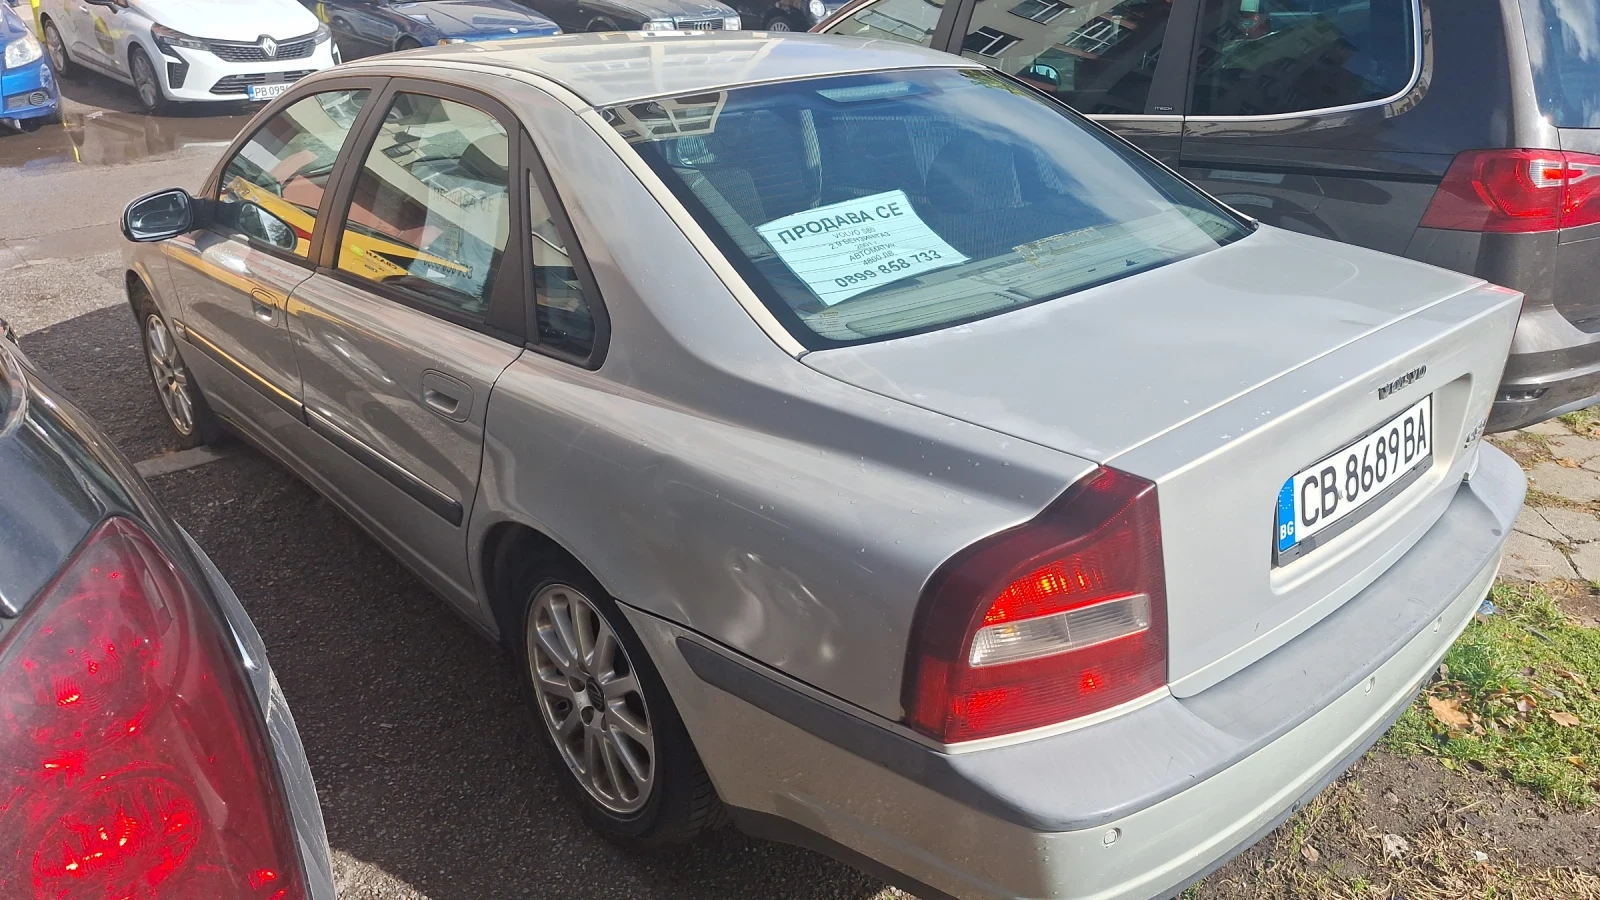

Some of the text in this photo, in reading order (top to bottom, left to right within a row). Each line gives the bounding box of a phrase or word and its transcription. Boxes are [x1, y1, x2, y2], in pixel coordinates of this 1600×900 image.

[777, 202, 904, 245] ПРОДАВА СЕ
[831, 229, 861, 239] VOLVO
[835, 249, 942, 288] 0899 858 733
[1345, 427, 1400, 503] 8689
[1279, 520, 1294, 541] BG
